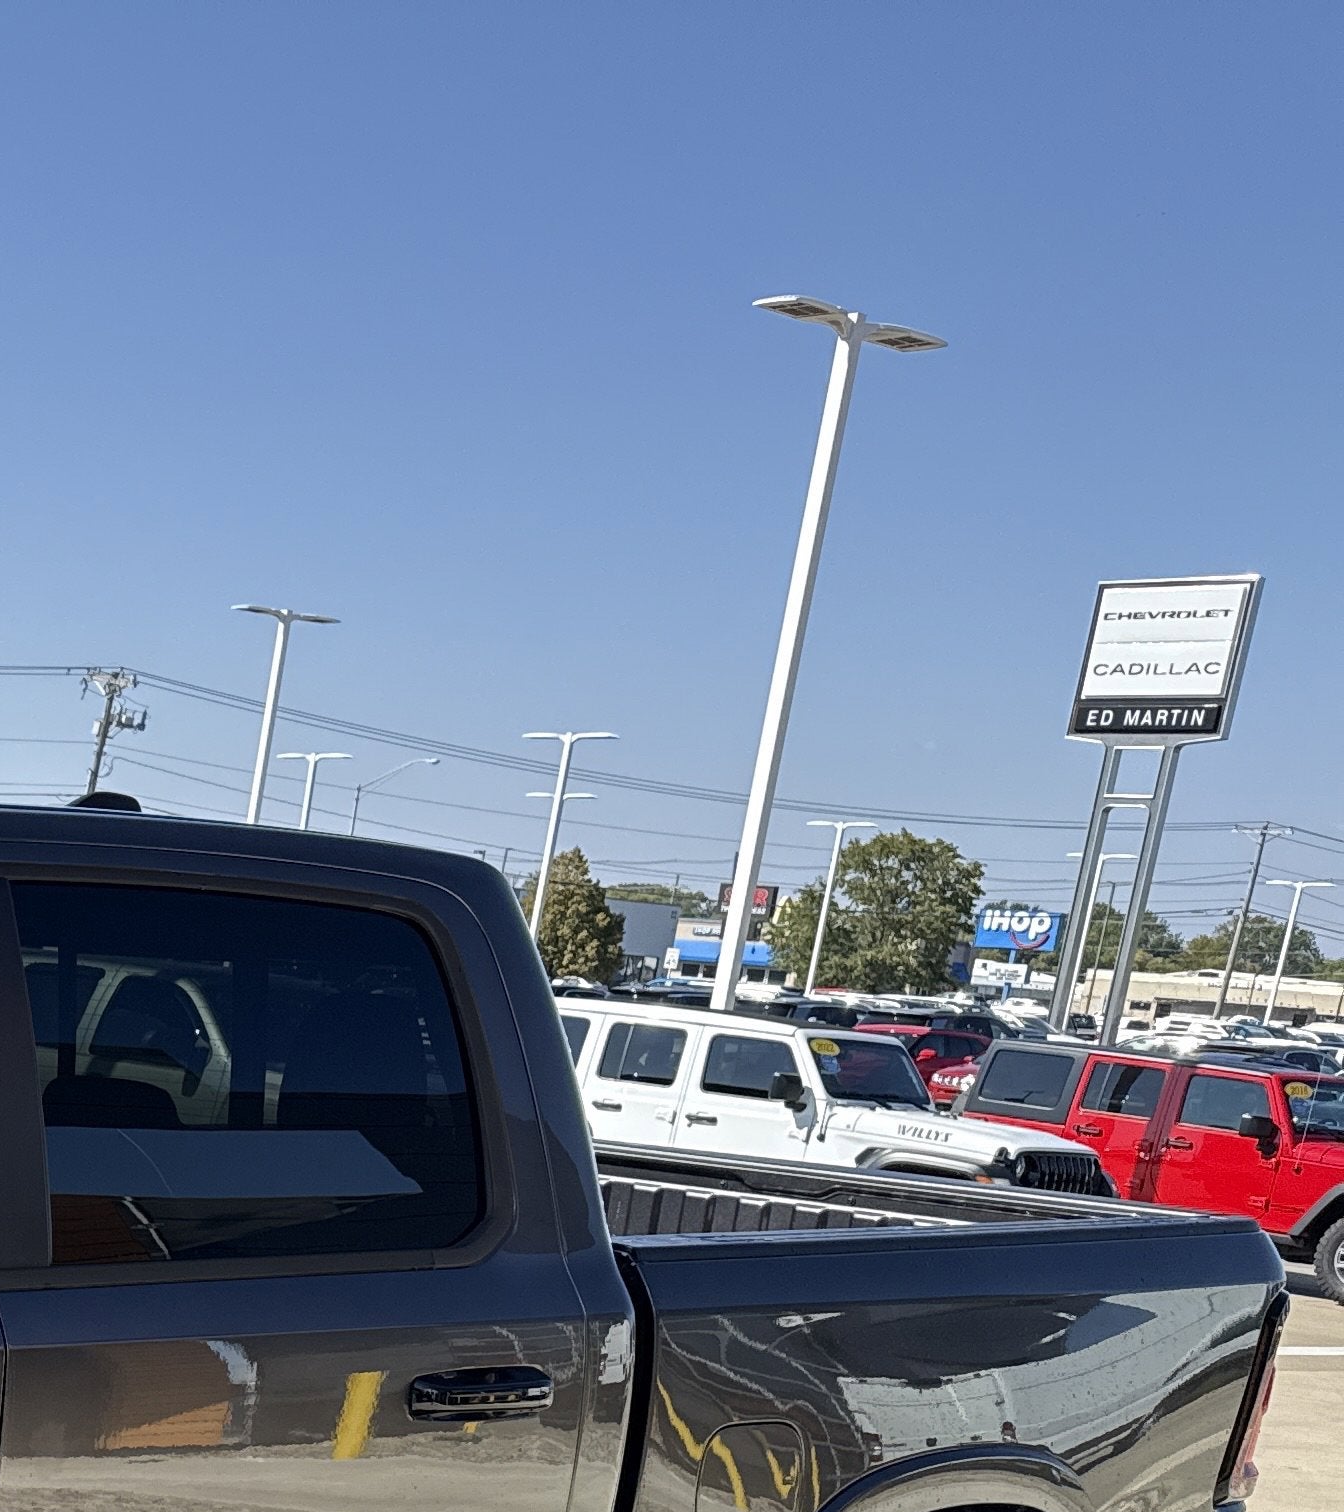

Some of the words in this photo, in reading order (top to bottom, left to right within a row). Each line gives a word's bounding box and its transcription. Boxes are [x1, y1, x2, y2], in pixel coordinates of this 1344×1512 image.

[1103, 608, 1234, 621] CHEVROLET
[1093, 662, 1222, 676] CADILLAC
[1085, 709, 1114, 727] ED
[1123, 708, 1206, 727] MARTIN
